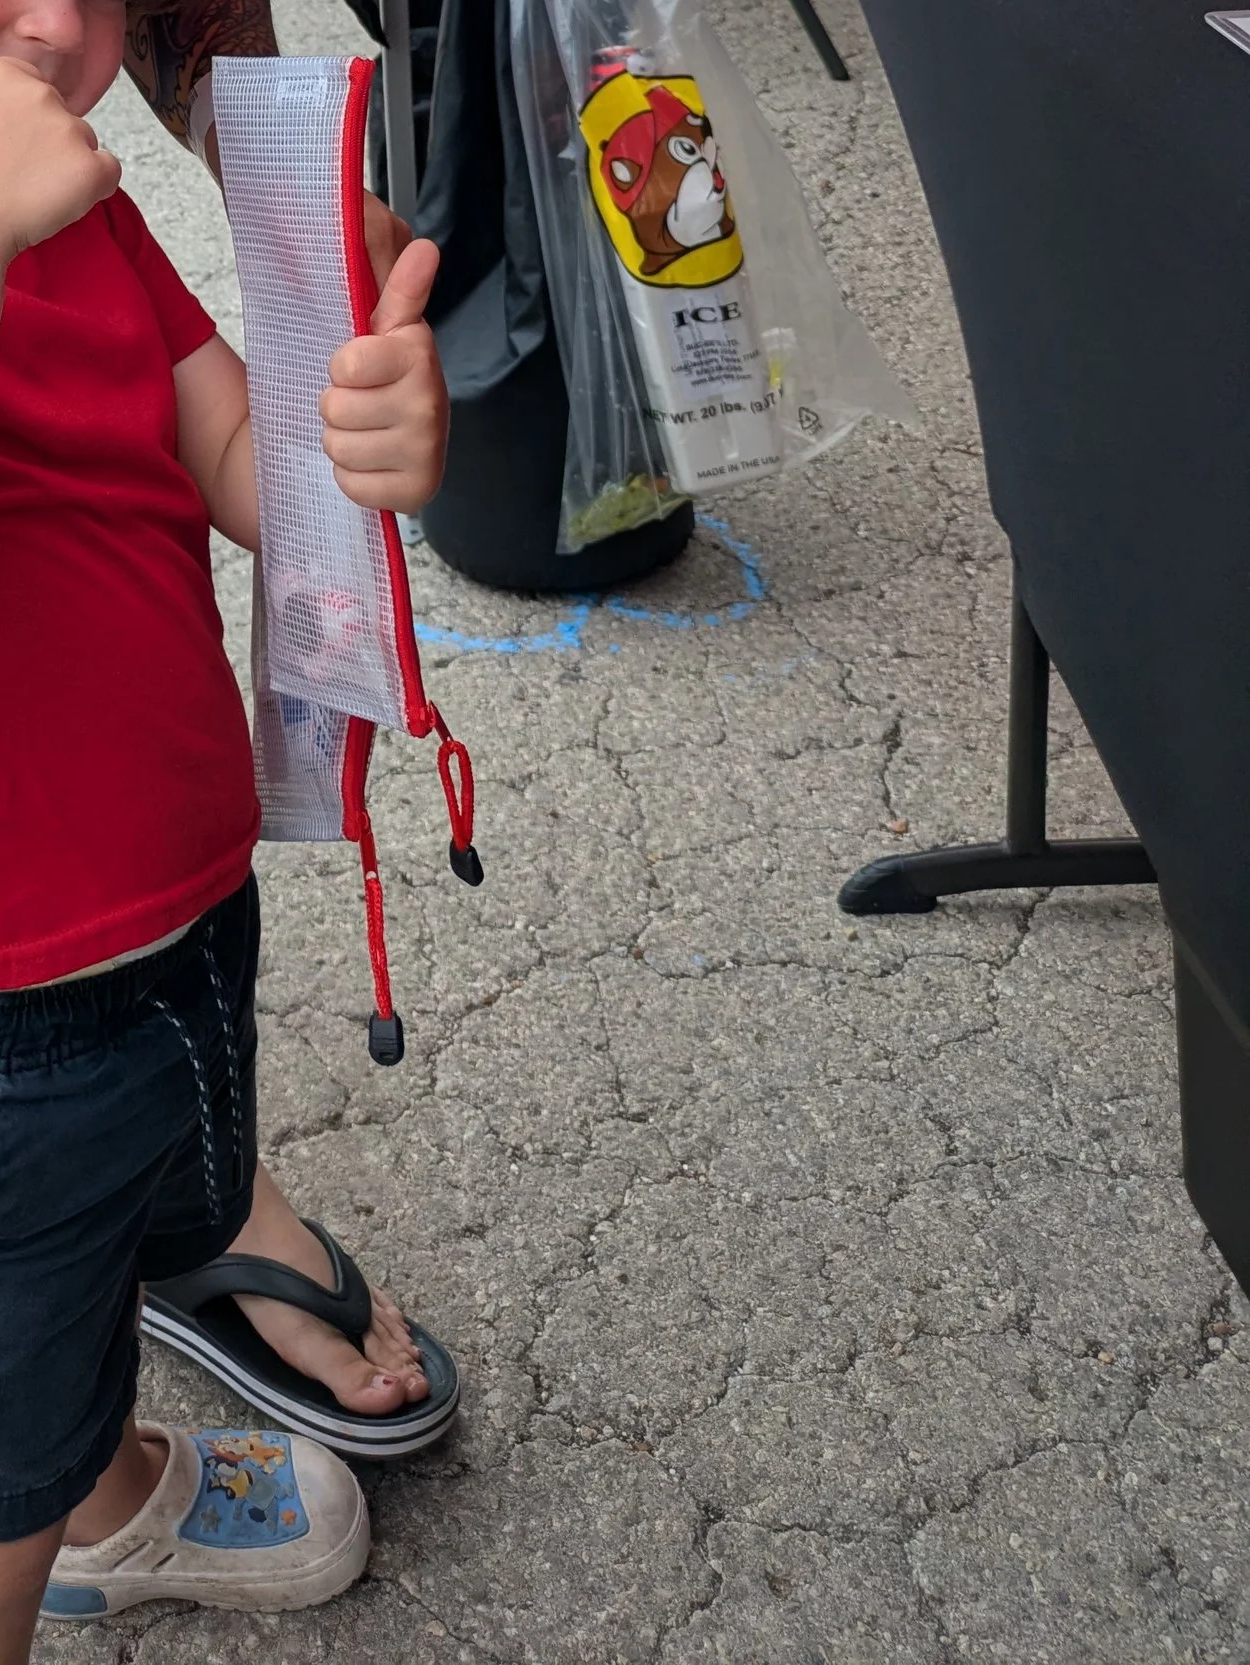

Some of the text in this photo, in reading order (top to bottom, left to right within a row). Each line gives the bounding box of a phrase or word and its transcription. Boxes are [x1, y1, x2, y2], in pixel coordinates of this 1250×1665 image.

[672, 302, 742, 328] ICE
[670, 410, 697, 424] WT.
[700, 404, 717, 419] 20
[720, 401, 746, 415] lbs.
[697, 455, 781, 478] MADE IN THE USA
